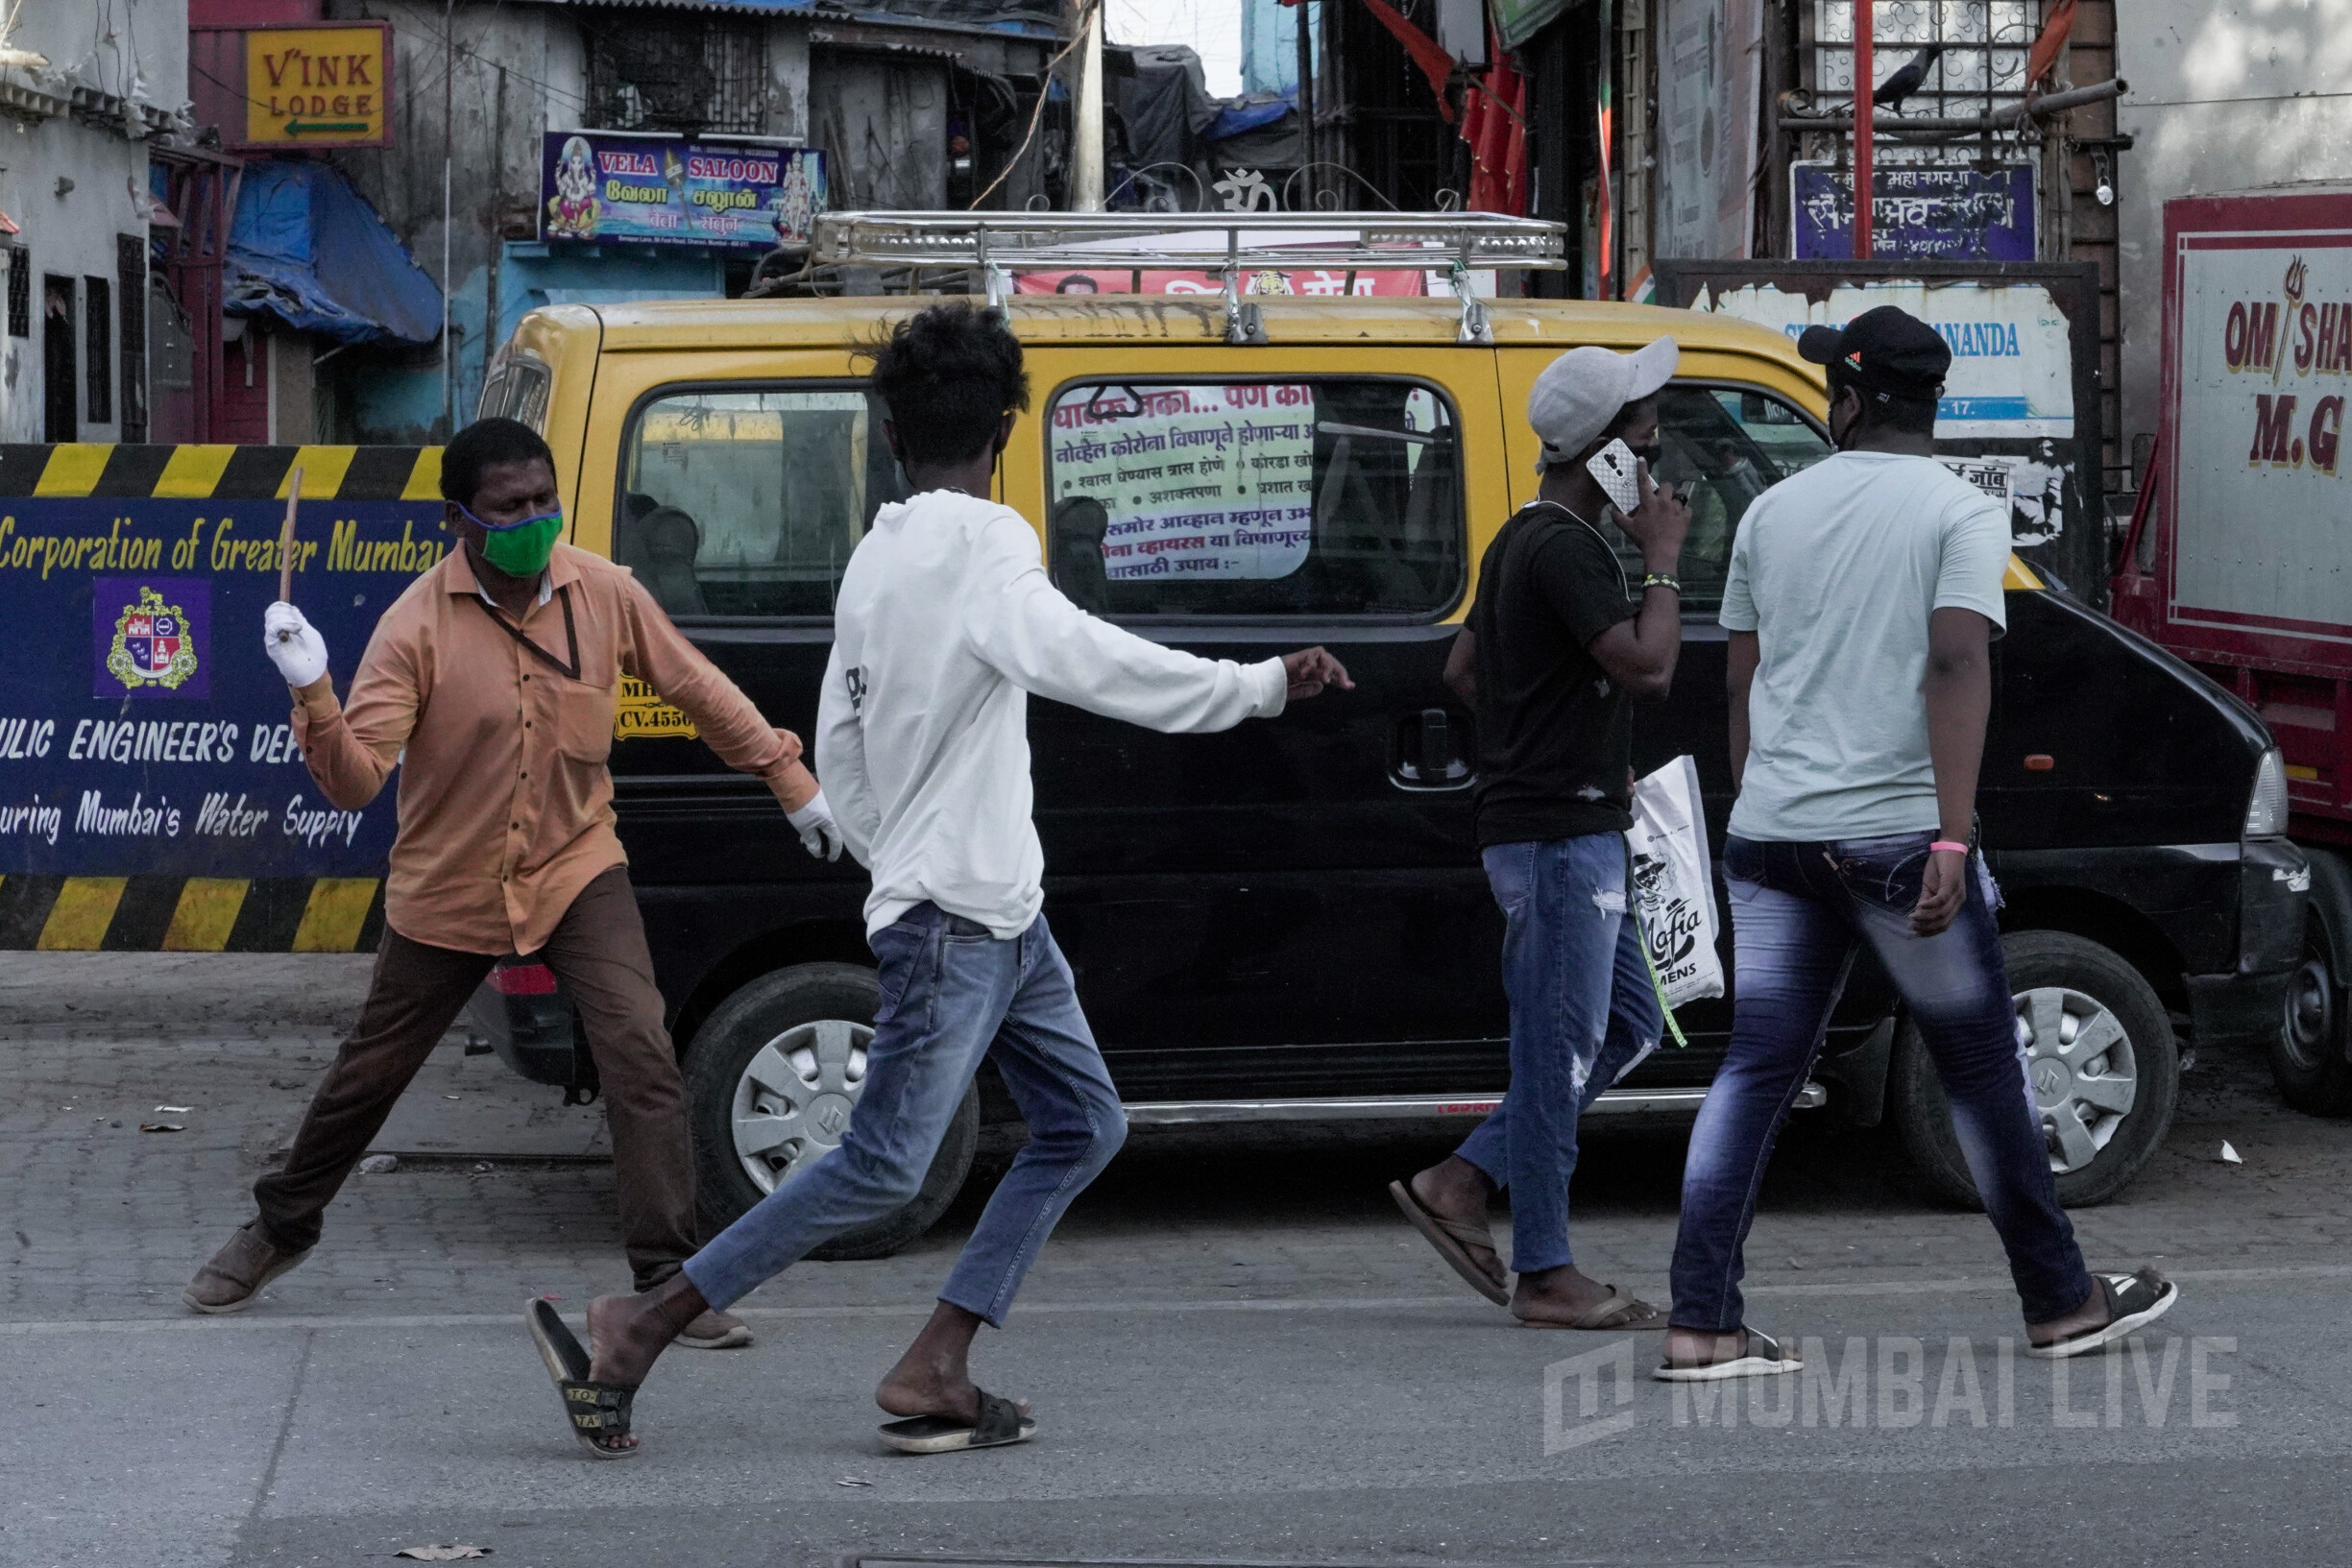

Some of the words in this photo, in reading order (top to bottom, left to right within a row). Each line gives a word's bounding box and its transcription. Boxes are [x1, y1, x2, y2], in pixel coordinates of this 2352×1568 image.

[270, 95, 373, 117] LODGE
[597, 151, 659, 177] VELA
[688, 157, 778, 184] SALOON
[605, 180, 669, 205] வேலா
[648, 208, 679, 229] वेला
[2225, 302, 2280, 374] OM
[1109, 430, 1166, 456] कोरोना
[1170, 421, 1233, 451] विषाणूने
[1160, 512, 1224, 529] आव्हान
[1227, 509, 1282, 528] म्हणून
[0, 516, 162, 581] Corporation
[172, 518, 206, 570] of
[327, 519, 447, 573] Mumbai
[1136, 536, 1206, 556] व्हायरस
[1209, 535, 1230, 547] या
[1174, 558, 1220, 571] उपाय
[68, 718, 238, 764] ENGINEER'S
[75, 789, 181, 837] Mumbai's
[195, 792, 269, 837] Water
[283, 794, 363, 849] Supply
